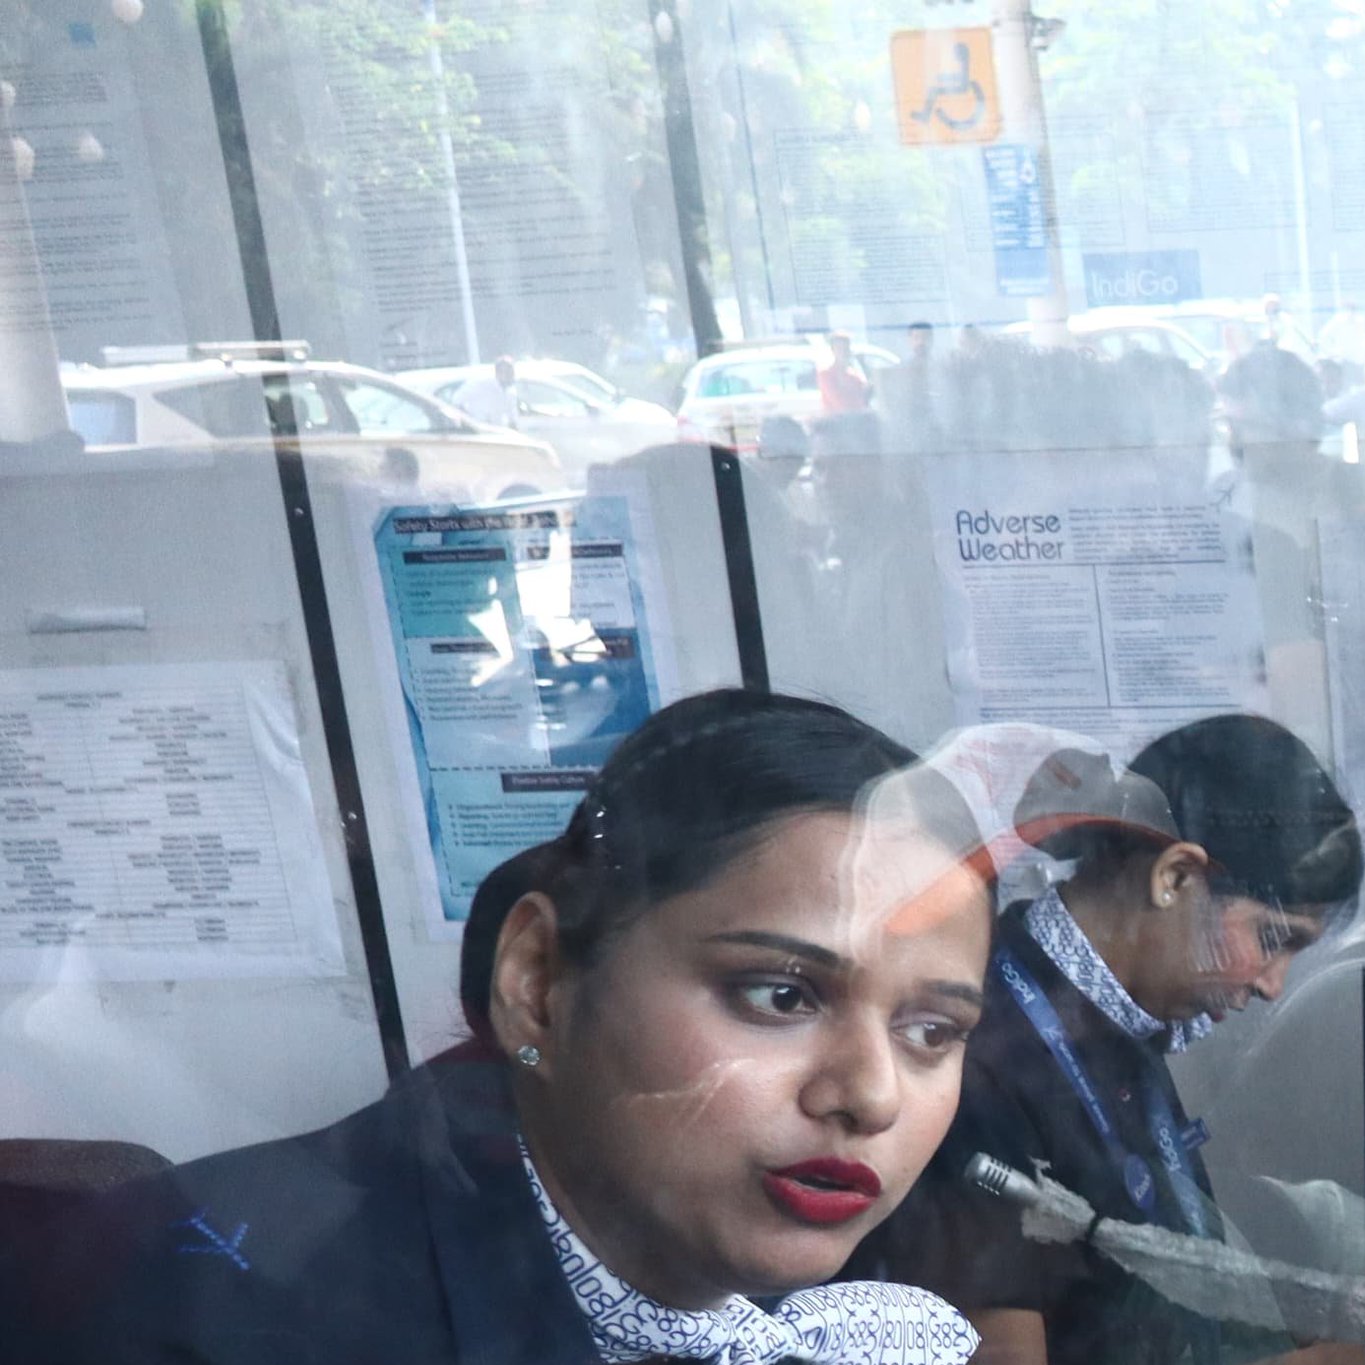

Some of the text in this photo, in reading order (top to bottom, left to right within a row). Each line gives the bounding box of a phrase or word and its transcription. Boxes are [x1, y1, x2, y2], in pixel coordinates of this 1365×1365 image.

[1091, 270, 1178, 297] IndiGo
[956, 508, 1061, 536] Adverse
[958, 536, 1064, 562] Weather
[1001, 962, 1037, 1004] IndiGo
